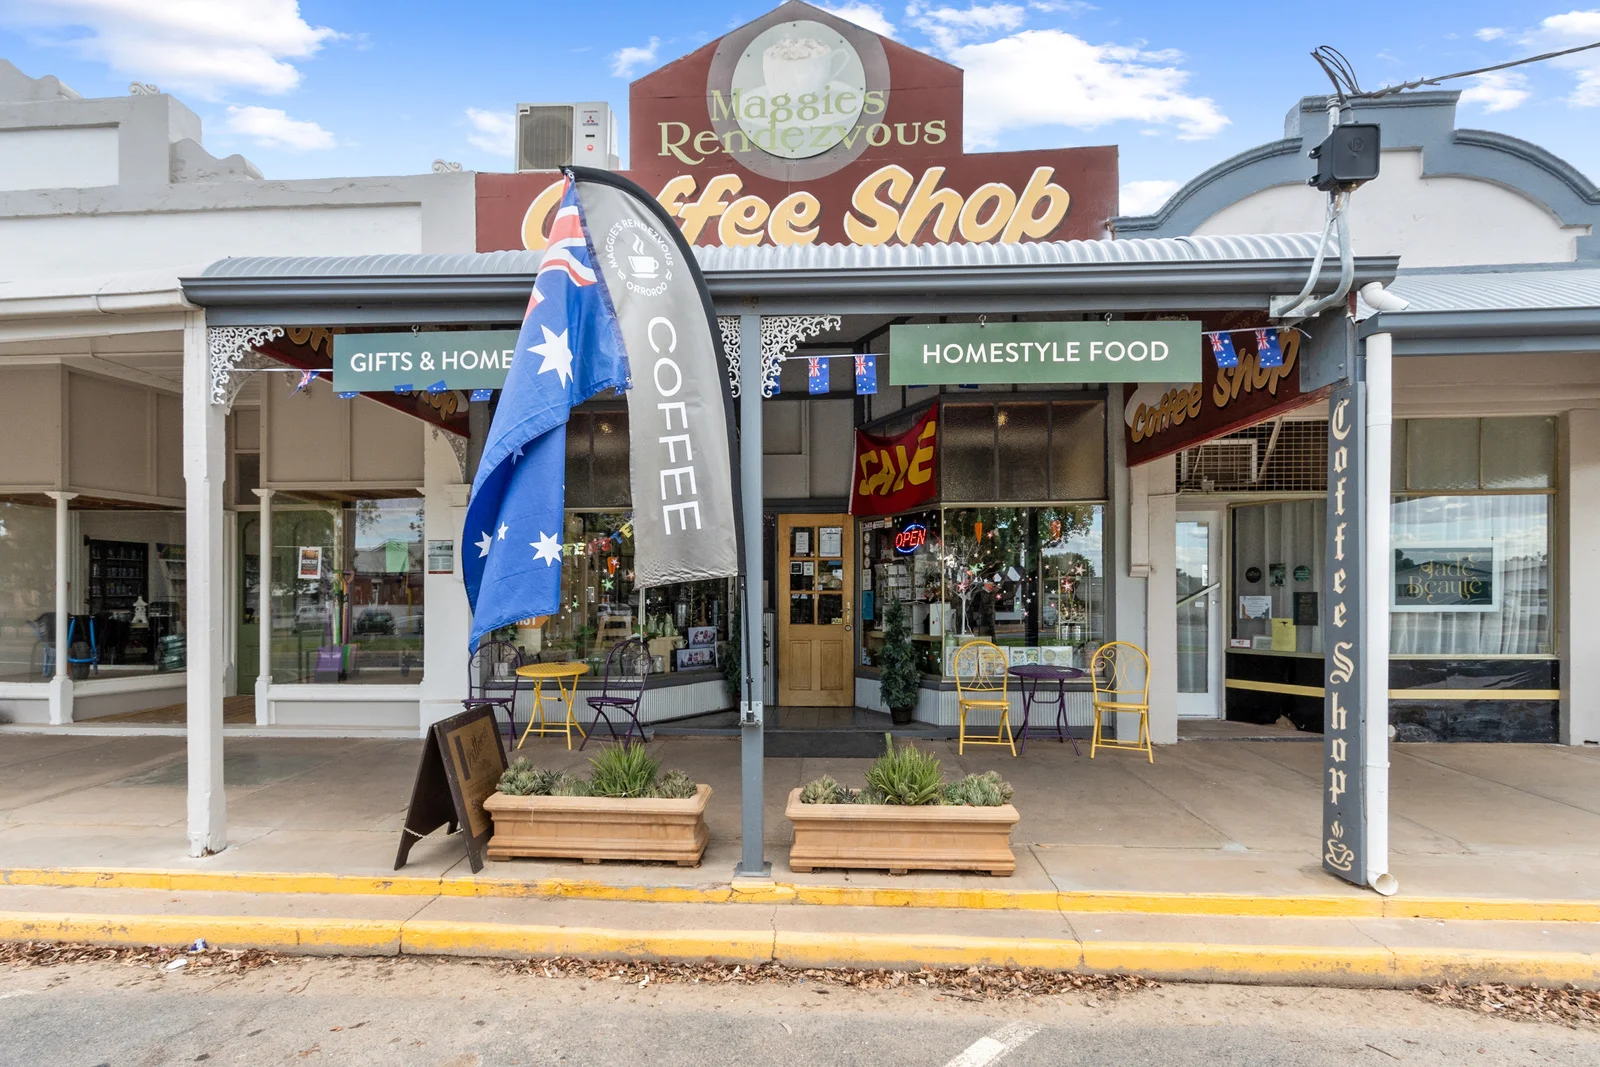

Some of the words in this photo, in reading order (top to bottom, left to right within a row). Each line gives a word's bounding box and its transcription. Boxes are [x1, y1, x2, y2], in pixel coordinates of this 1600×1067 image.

[657, 117, 947, 166] Rendezvous
[521, 173, 822, 249] Cffee
[843, 164, 1070, 246] Shop
[605, 222, 624, 269] MAGGIE'S
[621, 218, 674, 267] RENDEZVOUS
[626, 281, 668, 297] ORROROO
[350, 351, 413, 372] GIFTS
[419, 351, 435, 371] &
[923, 342, 1081, 364] HOMESTYLE
[1090, 341, 1169, 361] FOOD
[647, 316, 702, 536] COFFEE
[1131, 382, 1203, 443] Coffee
[1332, 397, 1352, 628] Coffee
[895, 529, 927, 548] OPEN
[1329, 641, 1355, 806] Shop
